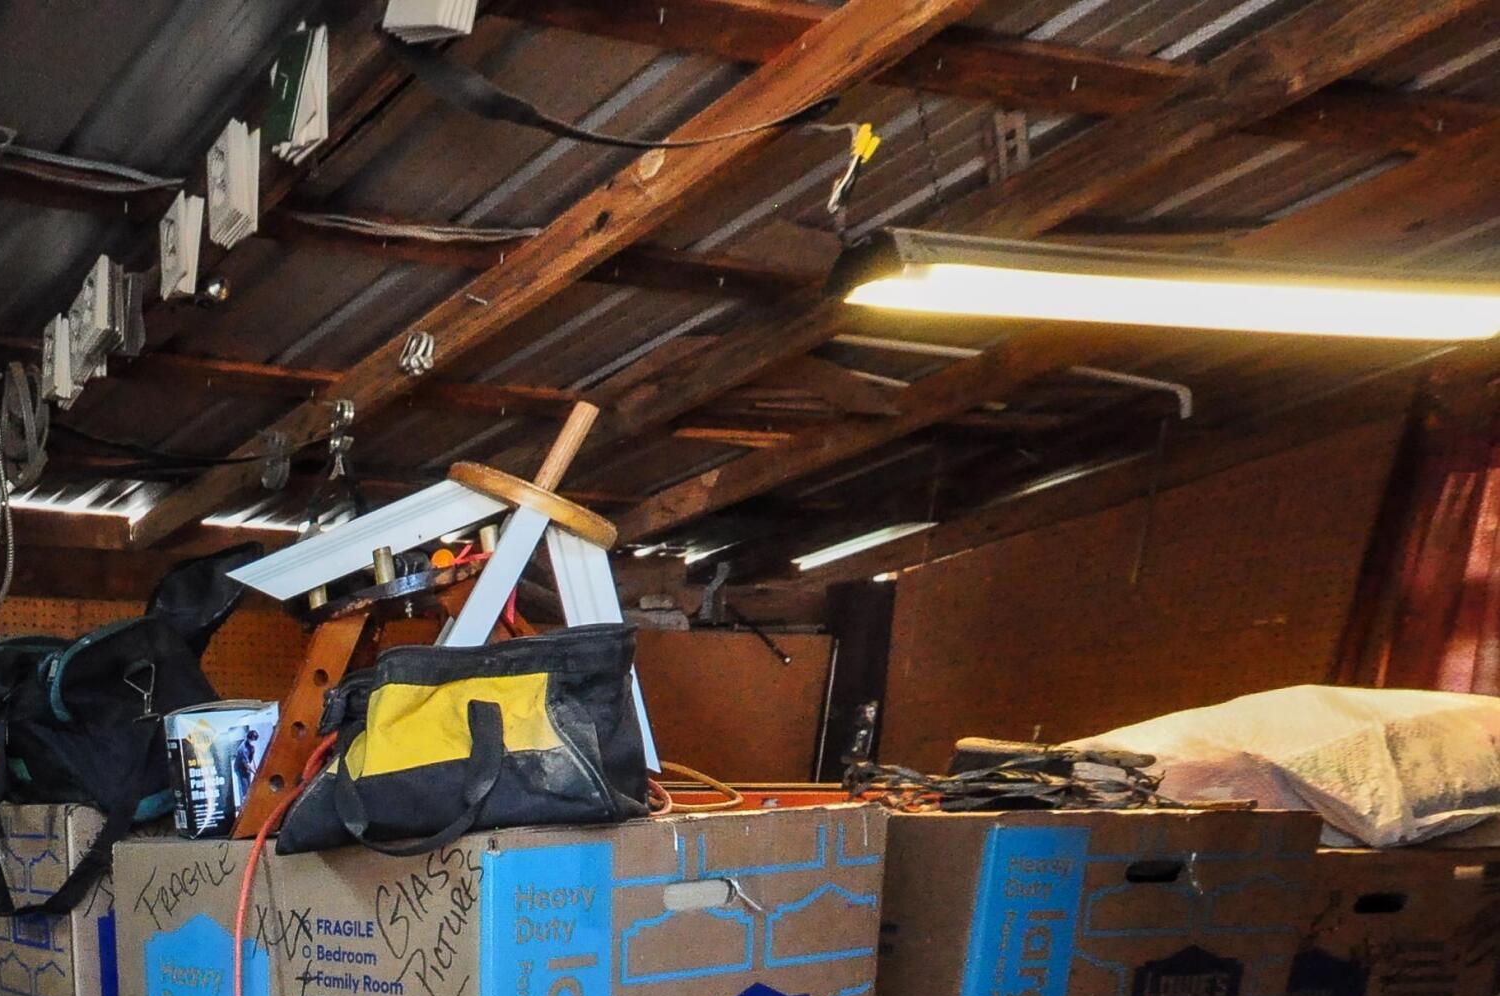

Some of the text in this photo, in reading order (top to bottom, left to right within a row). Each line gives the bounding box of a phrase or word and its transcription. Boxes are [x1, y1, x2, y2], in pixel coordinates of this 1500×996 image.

[515, 883, 597, 912] Heavy
[317, 919, 373, 938] FRAGILE
[516, 916, 576, 945] Duty
[317, 945, 377, 965] Bedroom
[317, 971, 403, 995] Family Room
